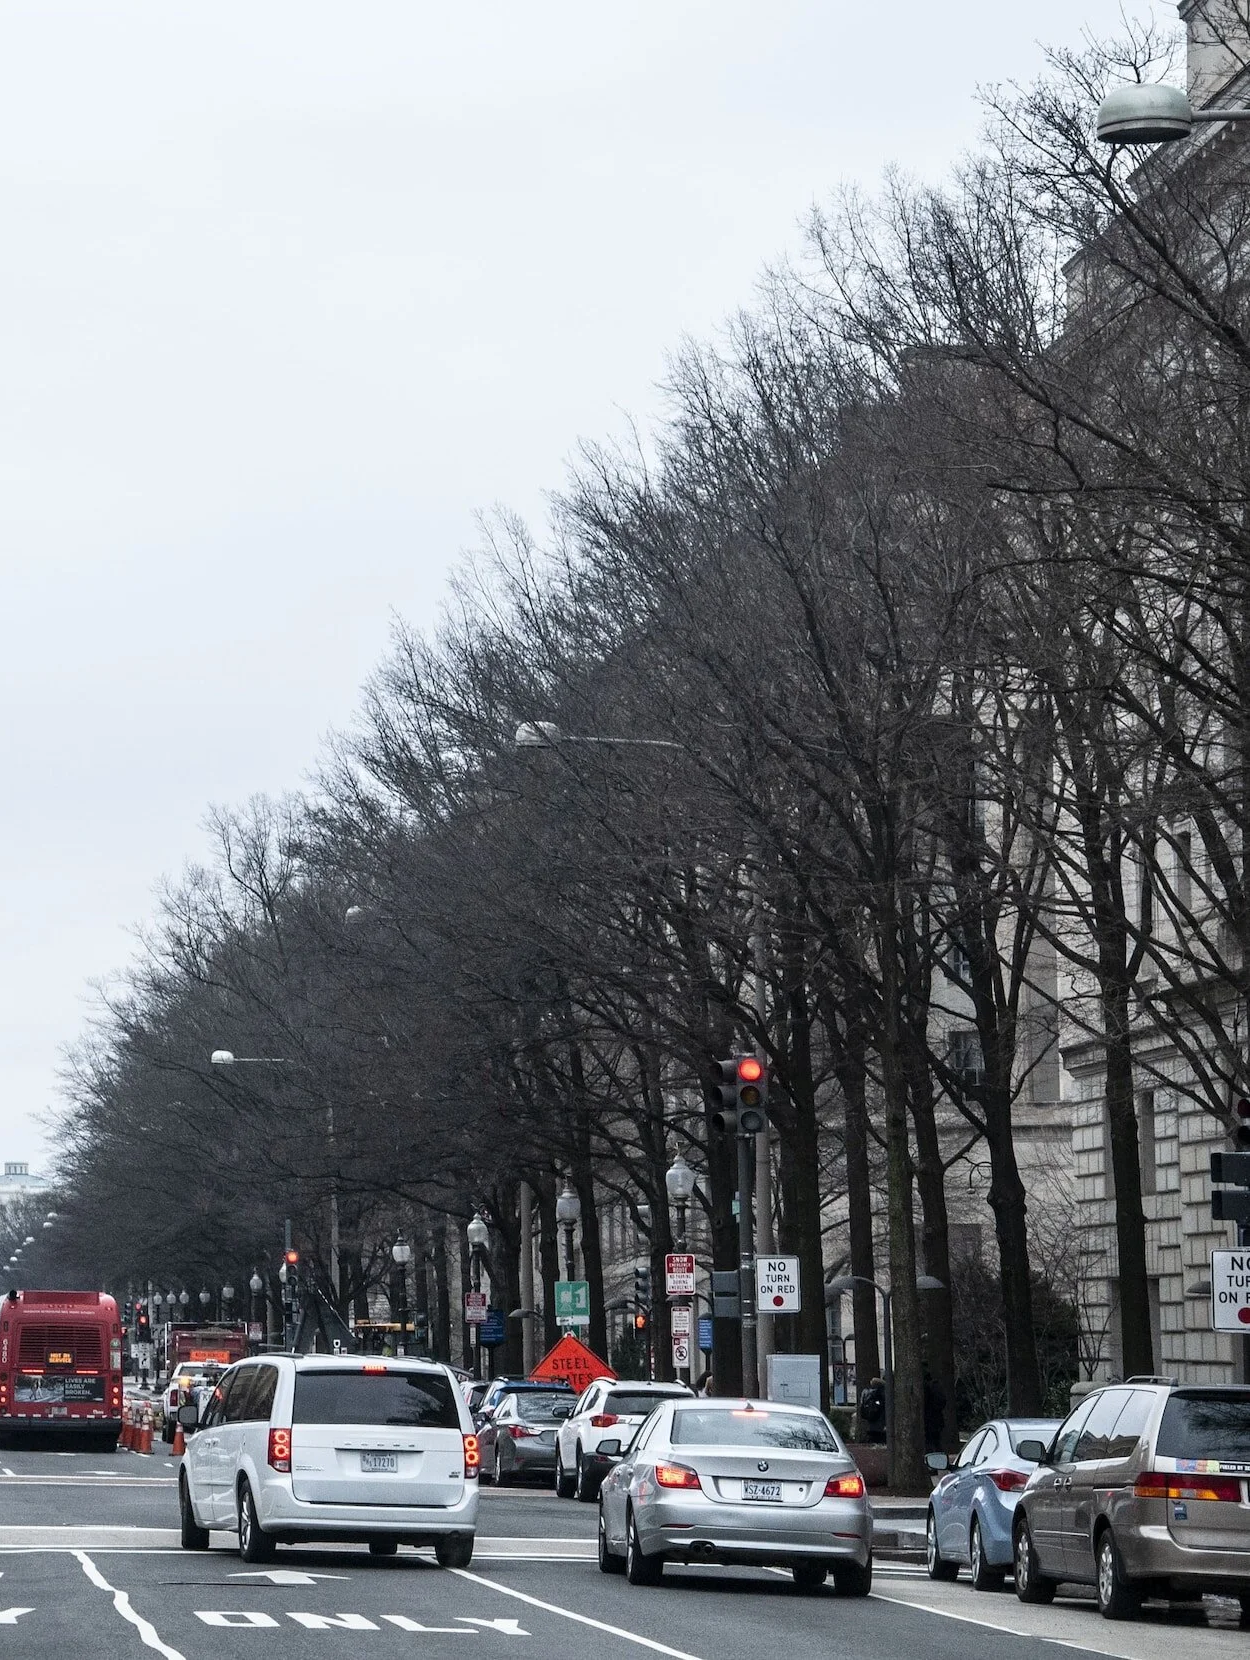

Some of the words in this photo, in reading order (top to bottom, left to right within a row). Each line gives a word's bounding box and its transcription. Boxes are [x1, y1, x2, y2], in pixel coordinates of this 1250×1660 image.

[768, 1261, 786, 1272] NO
[766, 1274, 790, 1283] TURN
[760, 1285, 773, 1294] ON
[778, 1285, 795, 1294] RED
[1219, 1291, 1238, 1304] ON
[552, 1357, 589, 1370] STEEL
[193, 1611, 532, 1636] ONLY
